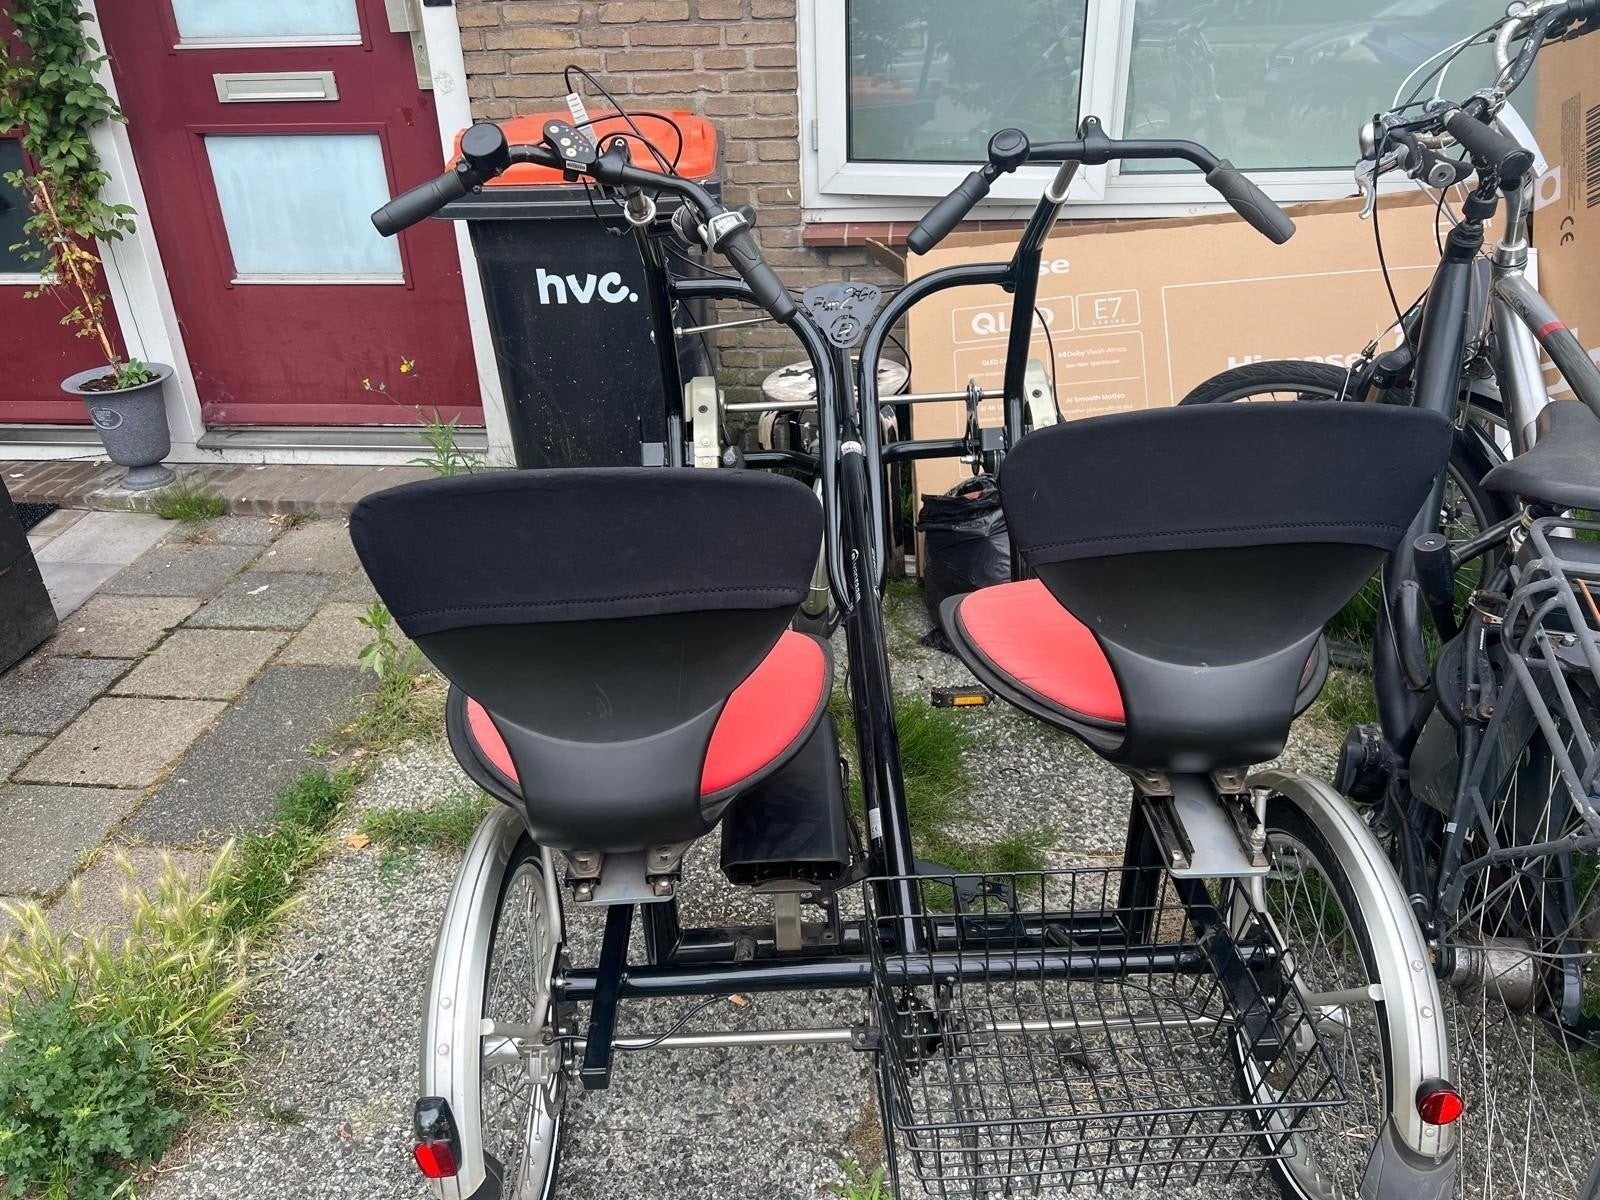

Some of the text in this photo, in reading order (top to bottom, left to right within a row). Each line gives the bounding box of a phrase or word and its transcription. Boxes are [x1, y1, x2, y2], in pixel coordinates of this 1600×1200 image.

[535, 268, 639, 304] hvc.
[971, 307, 1055, 336] QLD
[1094, 297, 1122, 320] E7
[1067, 350, 1085, 358] Dolby
